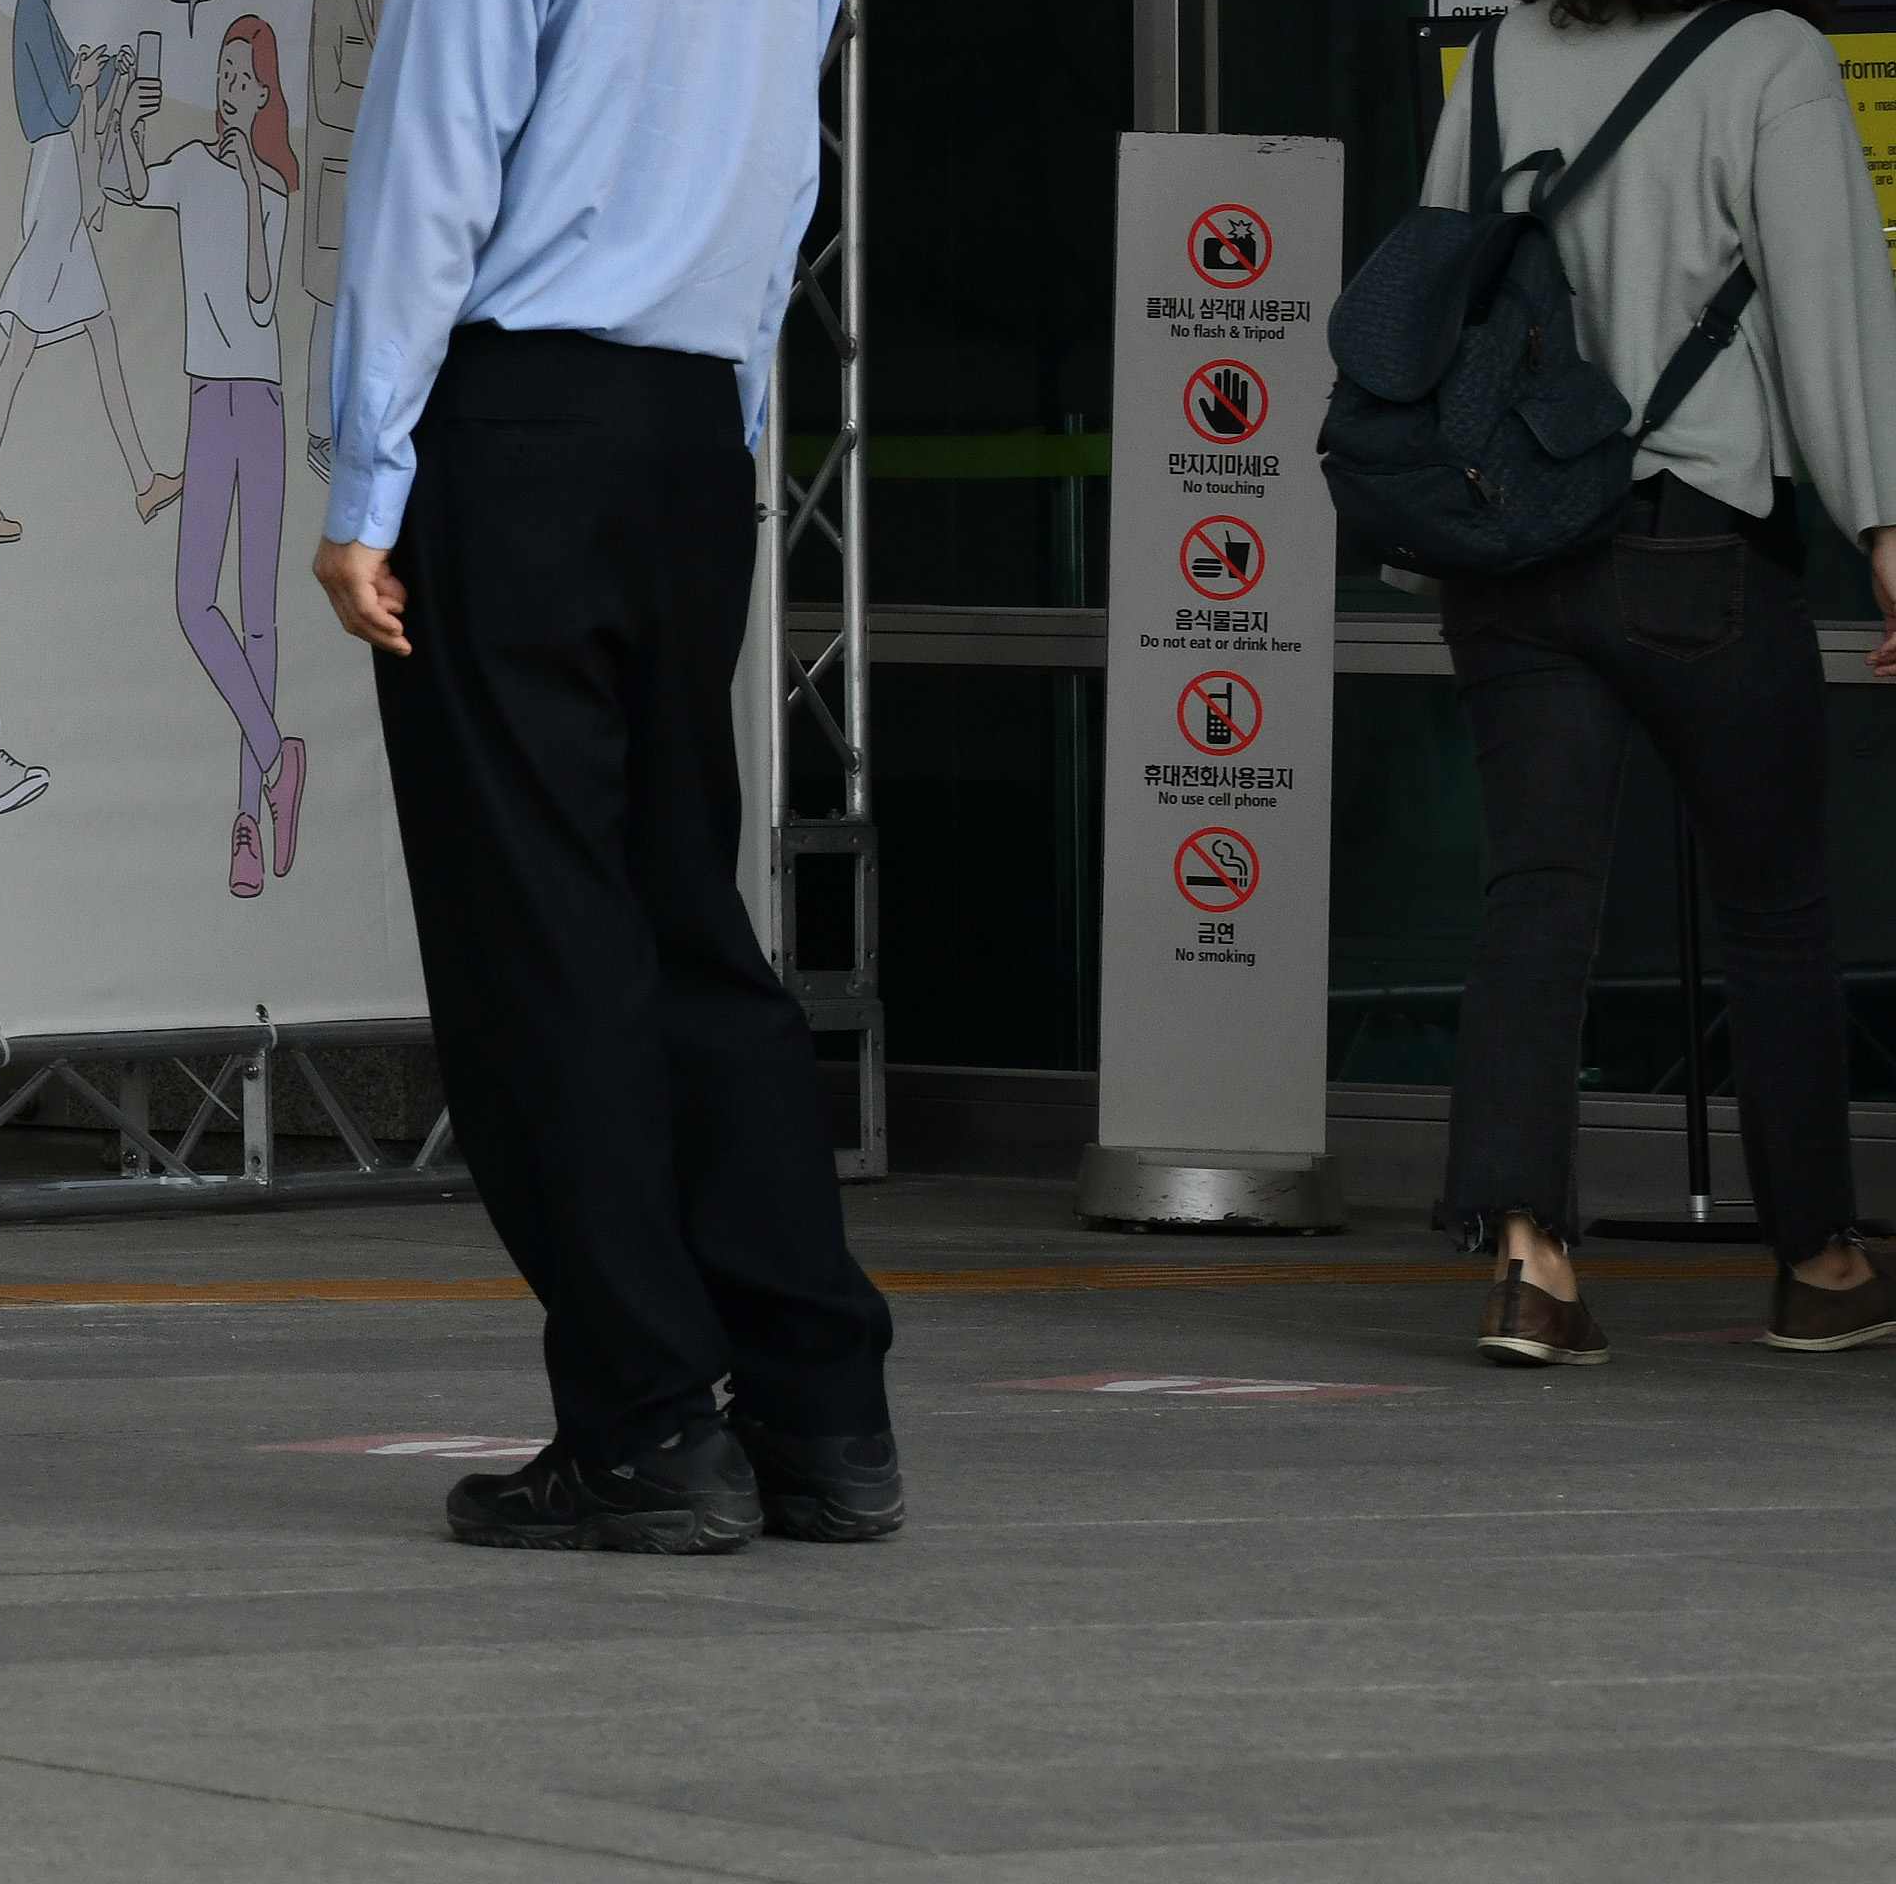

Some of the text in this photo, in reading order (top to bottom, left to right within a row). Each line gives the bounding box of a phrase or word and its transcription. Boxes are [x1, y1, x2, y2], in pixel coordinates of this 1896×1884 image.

[1839, 59, 1896, 80] nforma
[1146, 297, 1311, 323] 플래시, 삼각대 사용금지
[1170, 324, 1285, 343] No flash & Tripod
[1168, 453, 1281, 479] 만지지마세요
[1183, 479, 1265, 498] No touching
[1175, 609, 1269, 634] 음식물금지
[1140, 634, 1303, 653] Do not eat or drink here
[1143, 764, 1294, 791] 휴대전화사용금지
[1158, 790, 1277, 810] No use cell phone
[1197, 922, 1235, 946] 금연
[1175, 947, 1256, 967] No smoking
